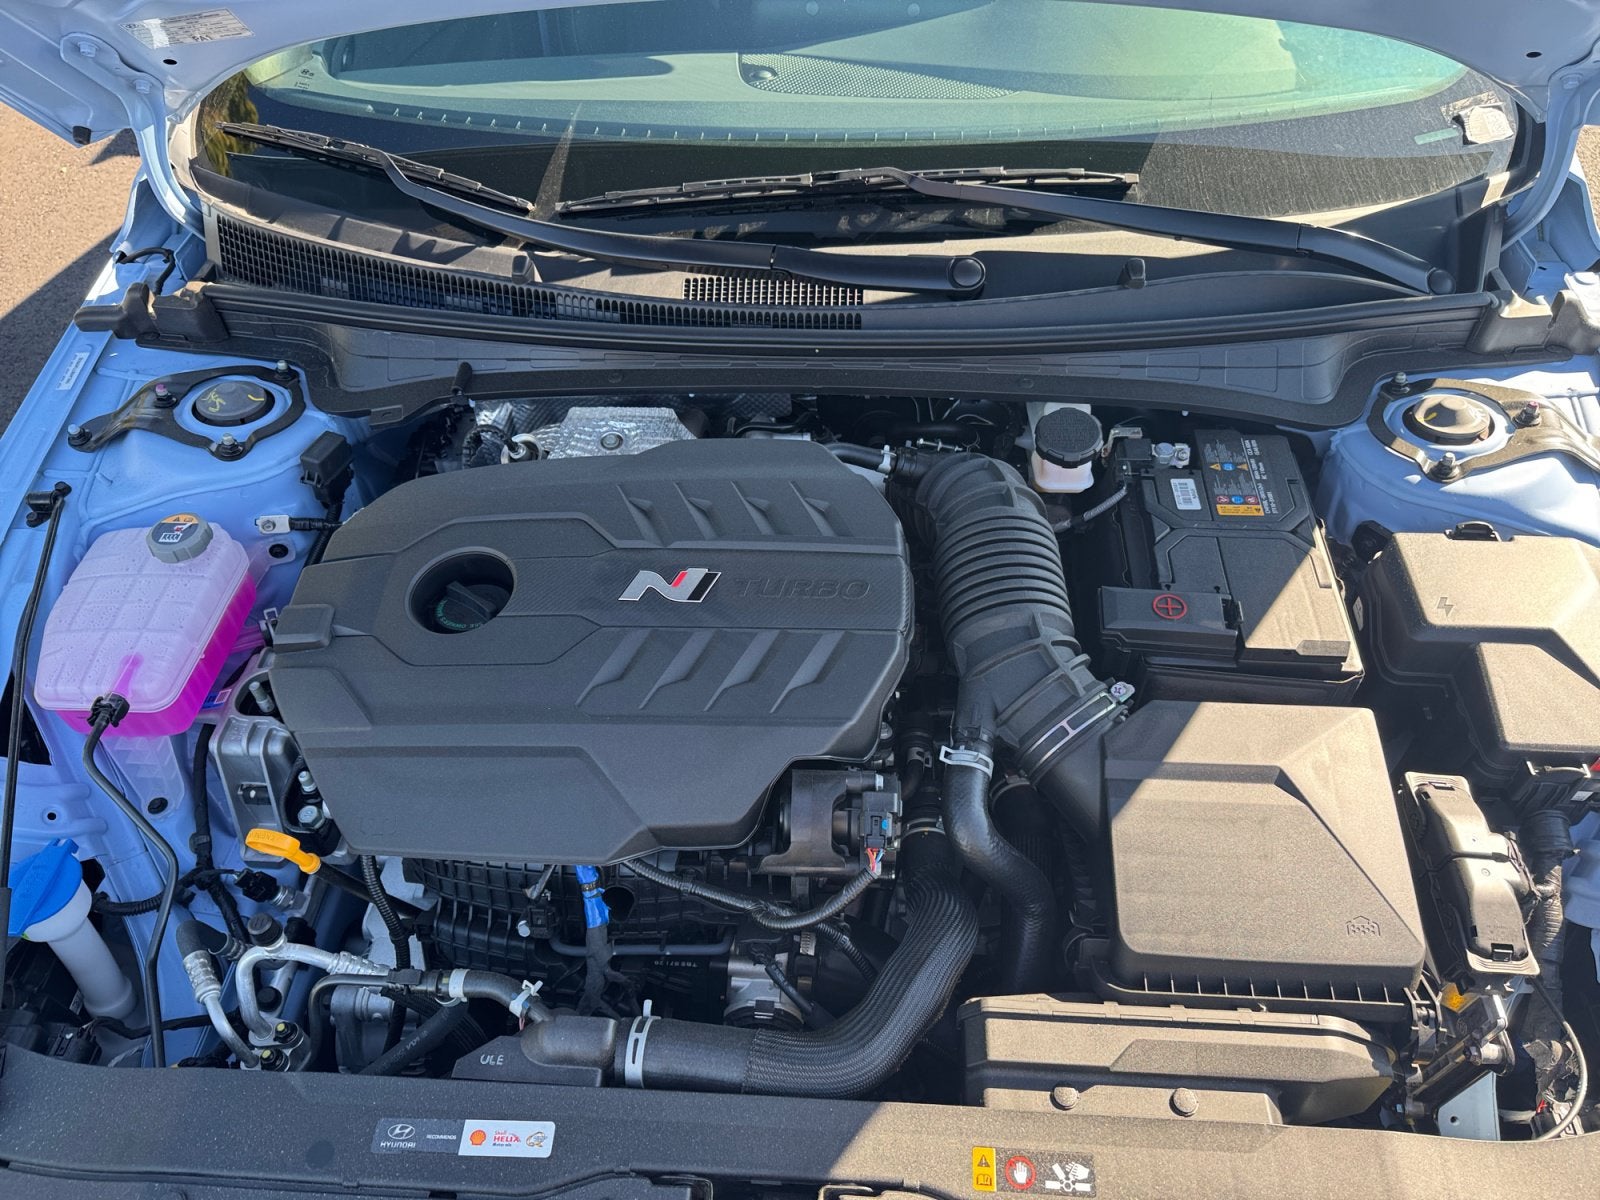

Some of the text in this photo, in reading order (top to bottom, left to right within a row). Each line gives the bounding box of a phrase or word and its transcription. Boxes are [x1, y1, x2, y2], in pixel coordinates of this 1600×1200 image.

[735, 577, 871, 600] TURBO
[493, 1135, 520, 1143] HELIX
[380, 1141, 416, 1149] HYUNDAI
